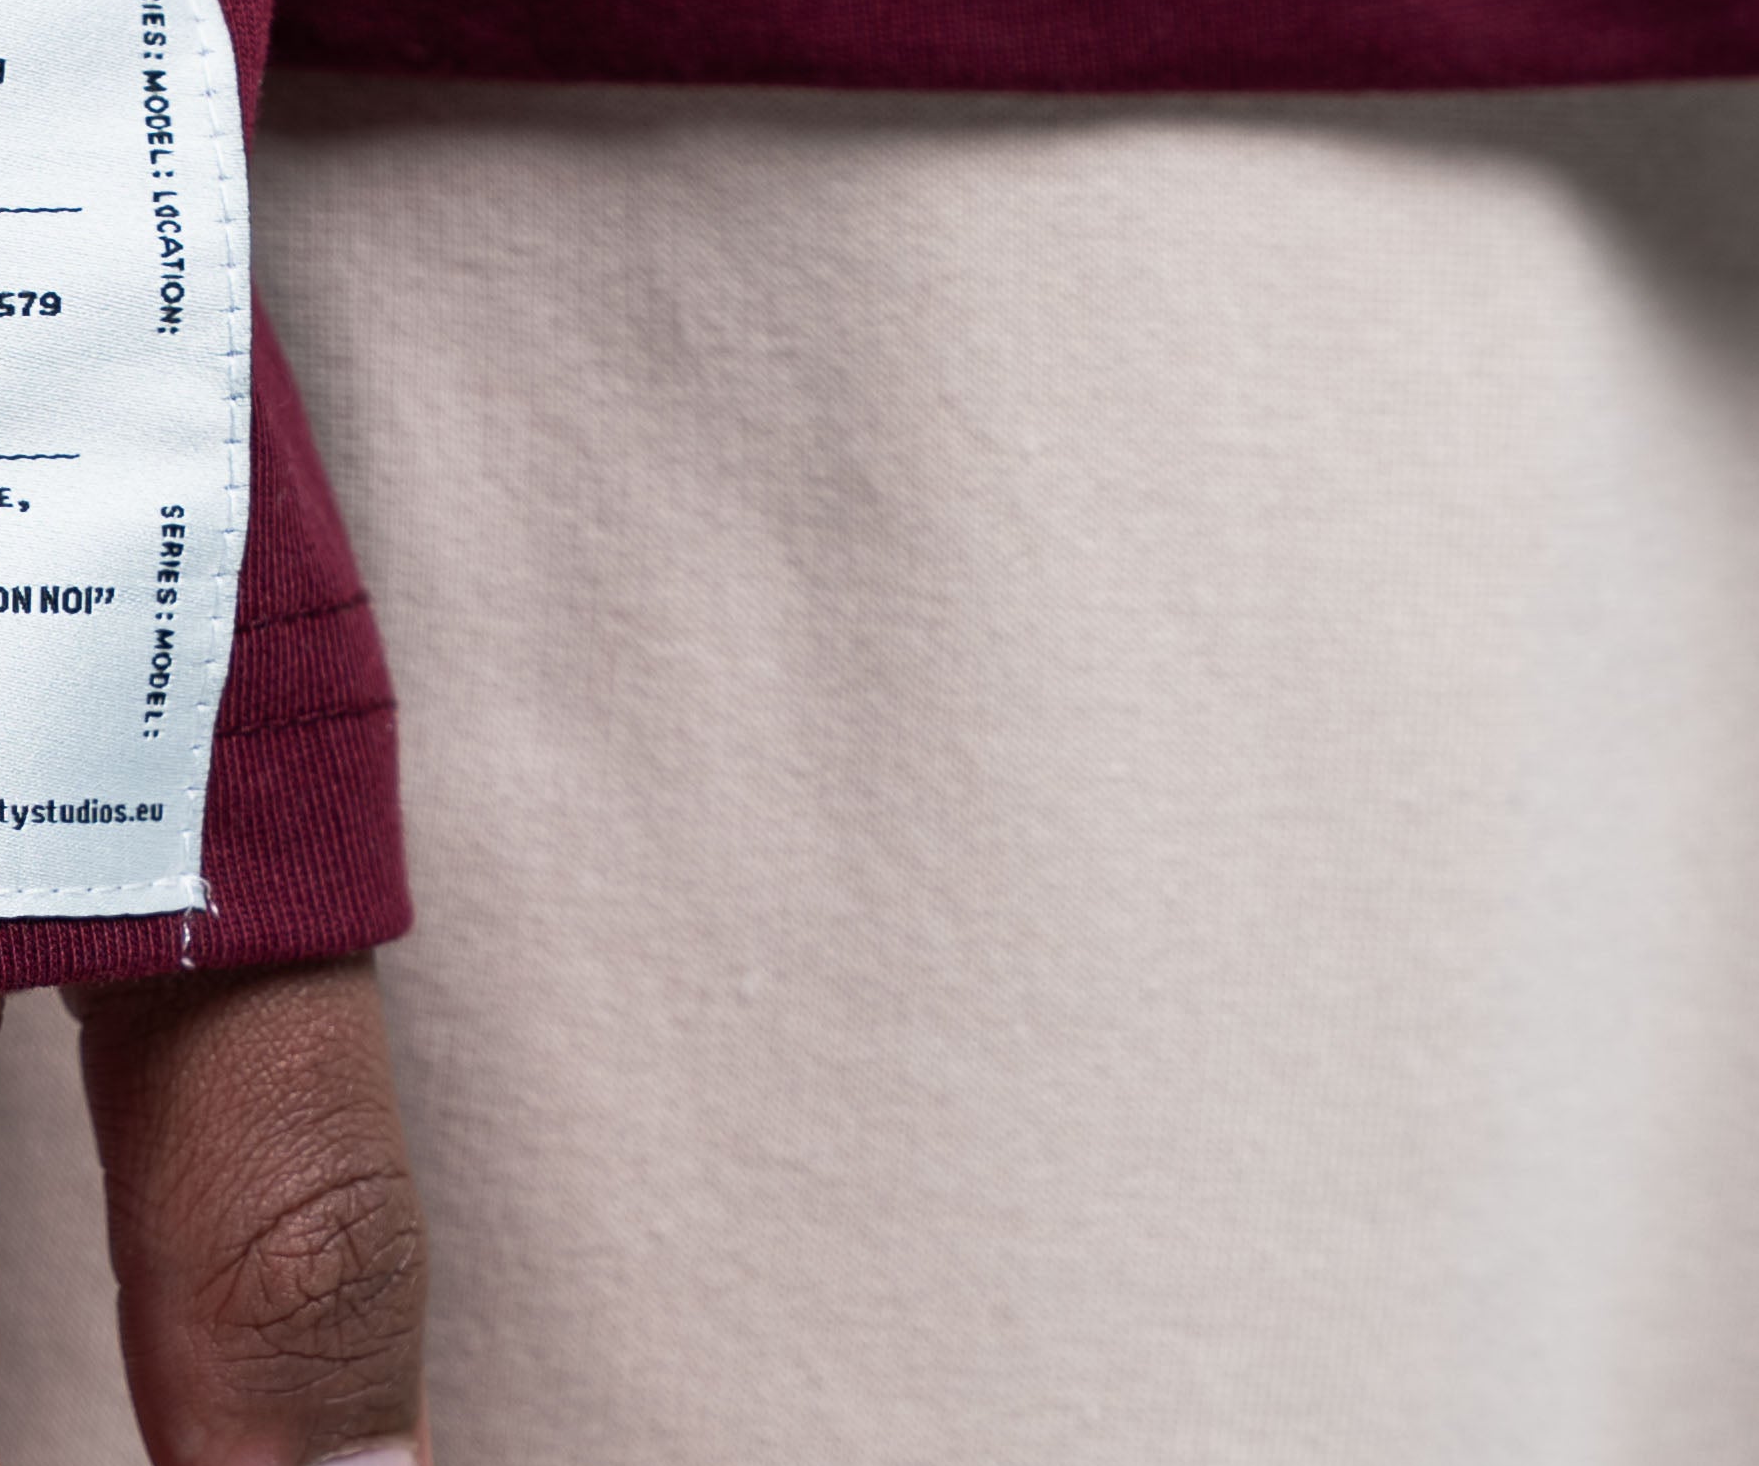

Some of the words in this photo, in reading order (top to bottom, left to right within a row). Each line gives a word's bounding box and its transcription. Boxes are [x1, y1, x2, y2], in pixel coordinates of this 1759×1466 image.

[141, 69, 175, 179] MODEL:
[151, 190, 186, 336] LOCATION:
[154, 504, 186, 621] SERIES:
[142, 628, 175, 739] MODEL:
